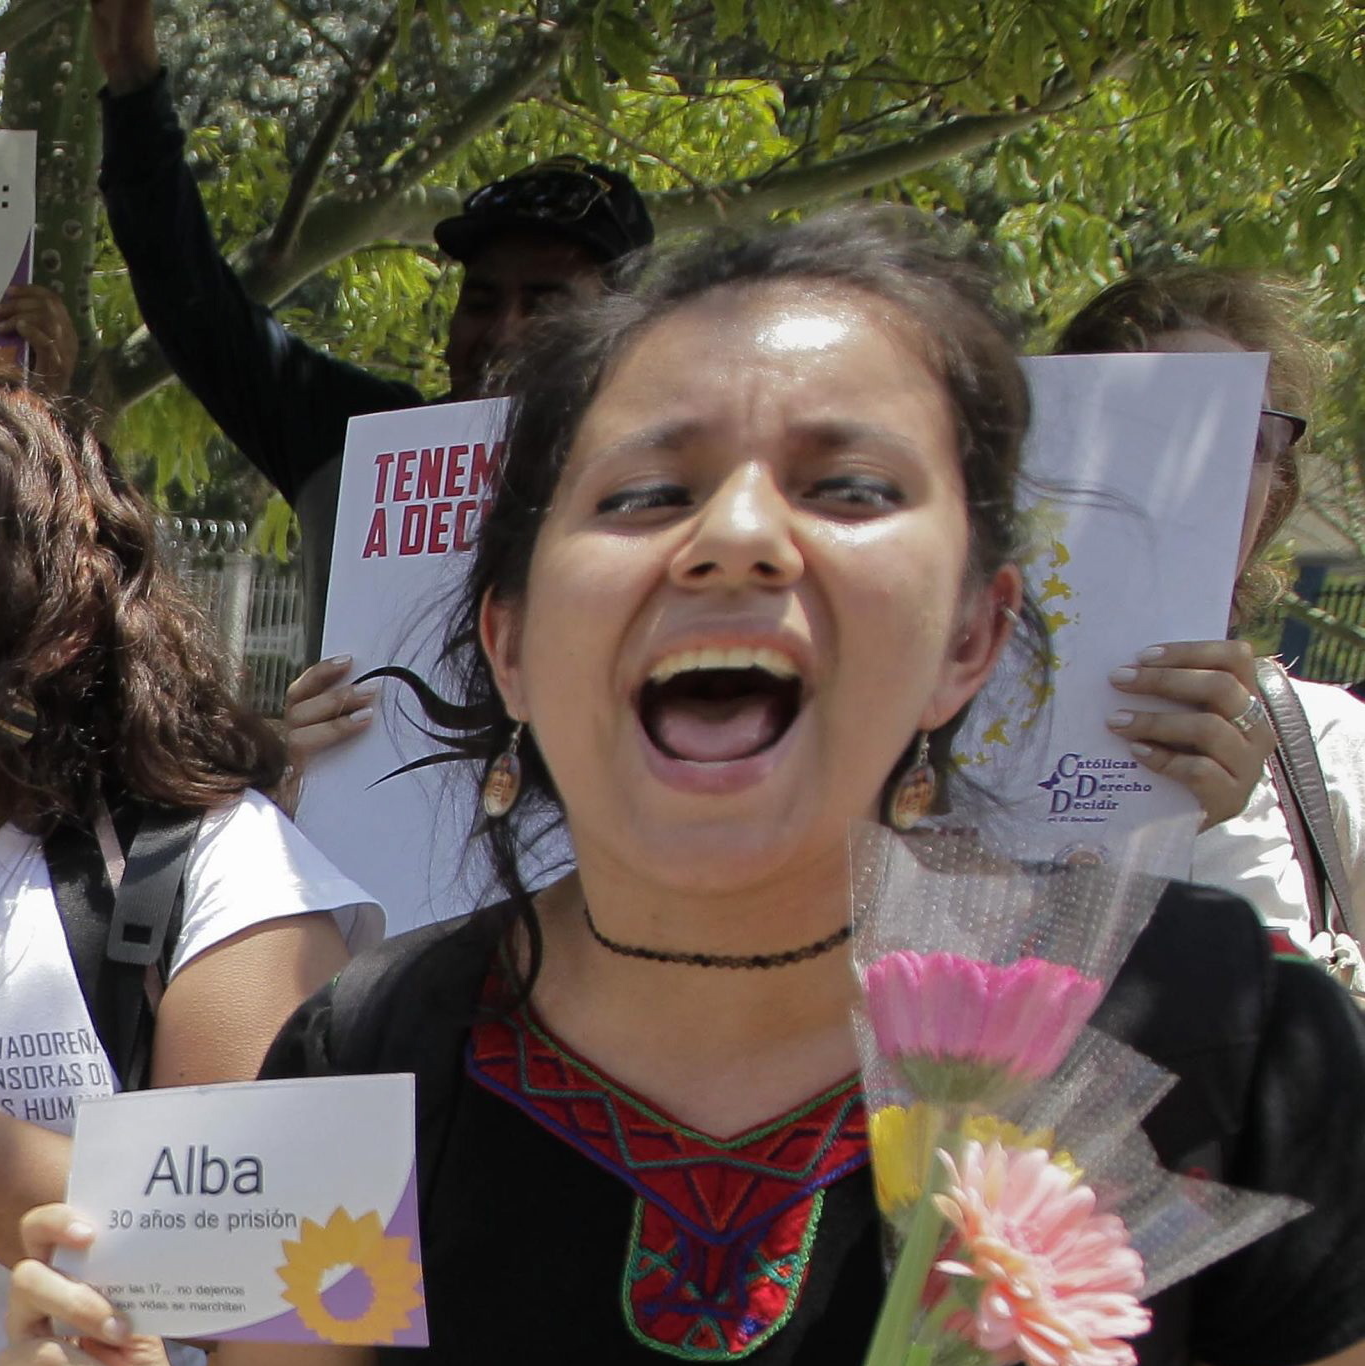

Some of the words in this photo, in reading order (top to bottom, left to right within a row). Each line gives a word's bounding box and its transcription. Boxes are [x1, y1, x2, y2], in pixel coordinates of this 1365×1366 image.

[374, 441, 506, 503] TENEM
[362, 508, 387, 558] A
[400, 501, 491, 557] DEC
[1057, 752, 1138, 778] Católicas
[1076, 774, 1153, 799] Derecho
[1050, 789, 1120, 814] Decidir
[25, 1096, 76, 1121] HUM
[143, 1144, 265, 1196] Alba
[108, 1209, 133, 1230] 30
[139, 1208, 187, 1230] años
[193, 1208, 220, 1230] de
[227, 1207, 298, 1232] prisión
